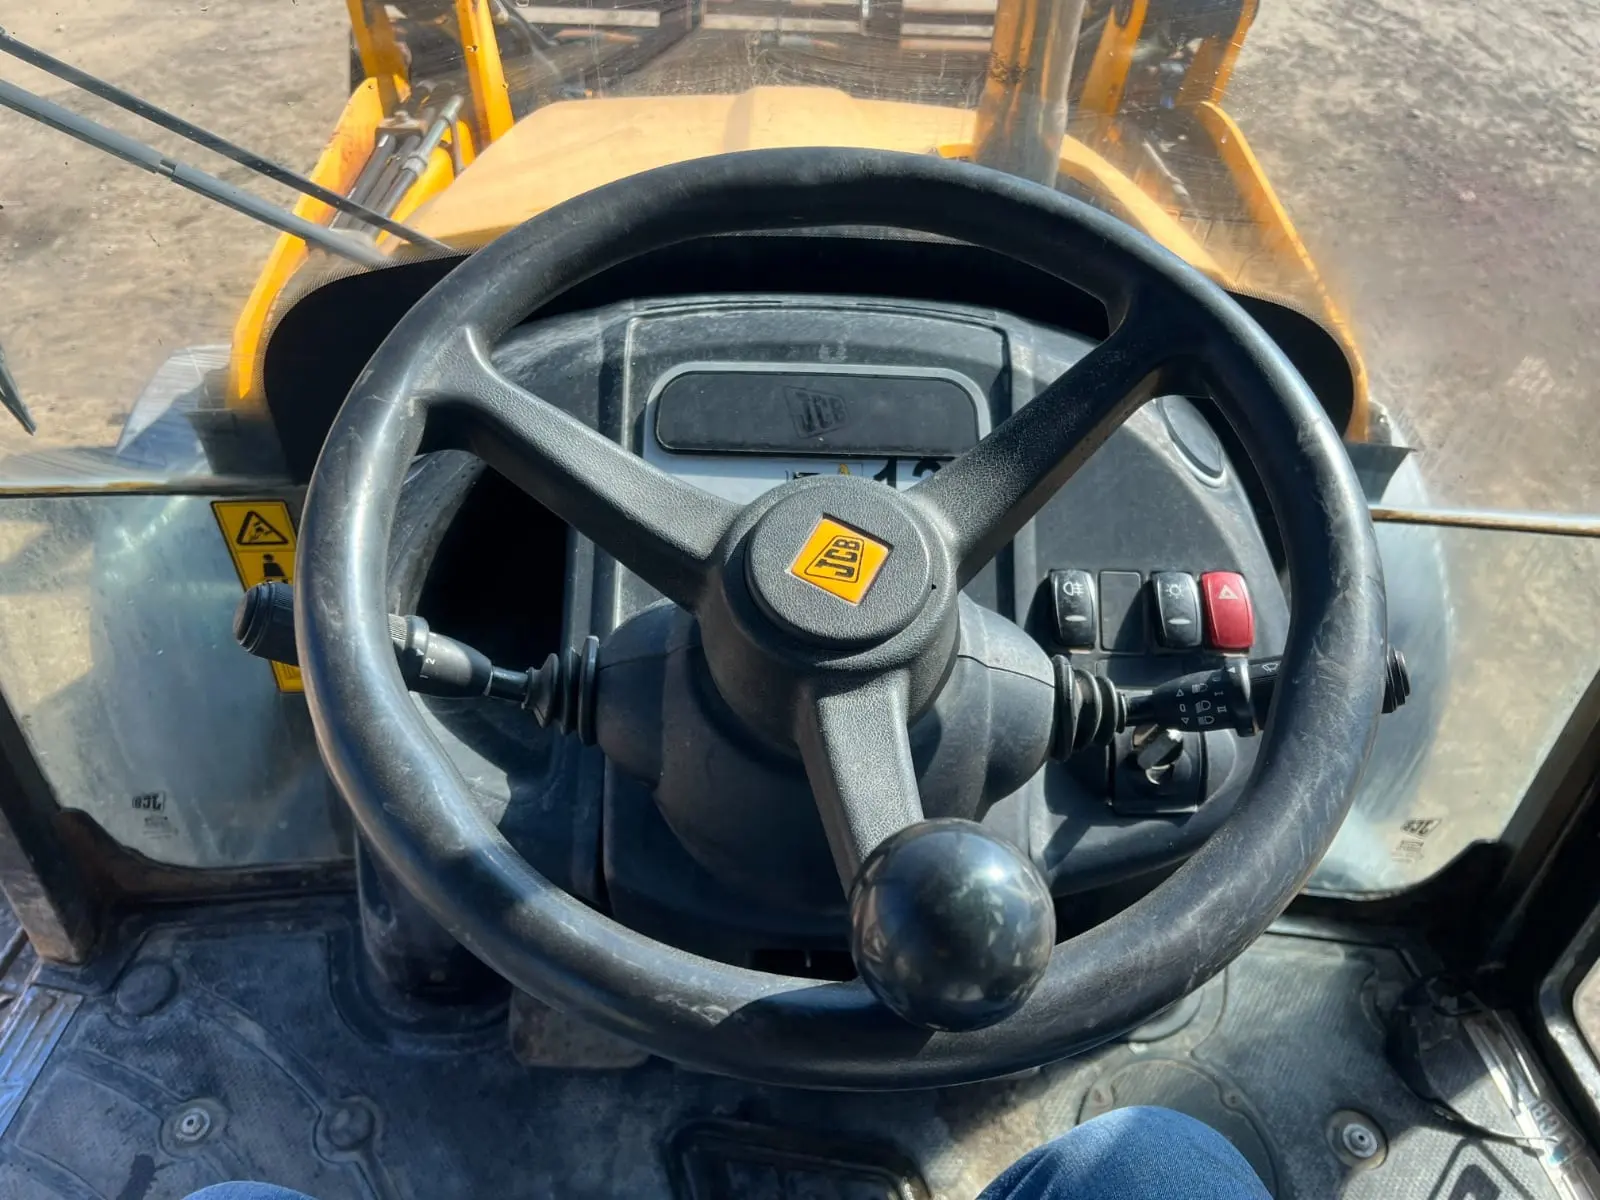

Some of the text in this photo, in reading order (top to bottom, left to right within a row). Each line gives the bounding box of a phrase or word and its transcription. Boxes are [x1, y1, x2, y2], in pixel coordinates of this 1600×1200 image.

[799, 391, 845, 433] JCB
[814, 538, 861, 579] JCB
[425, 657, 436, 665] 2
